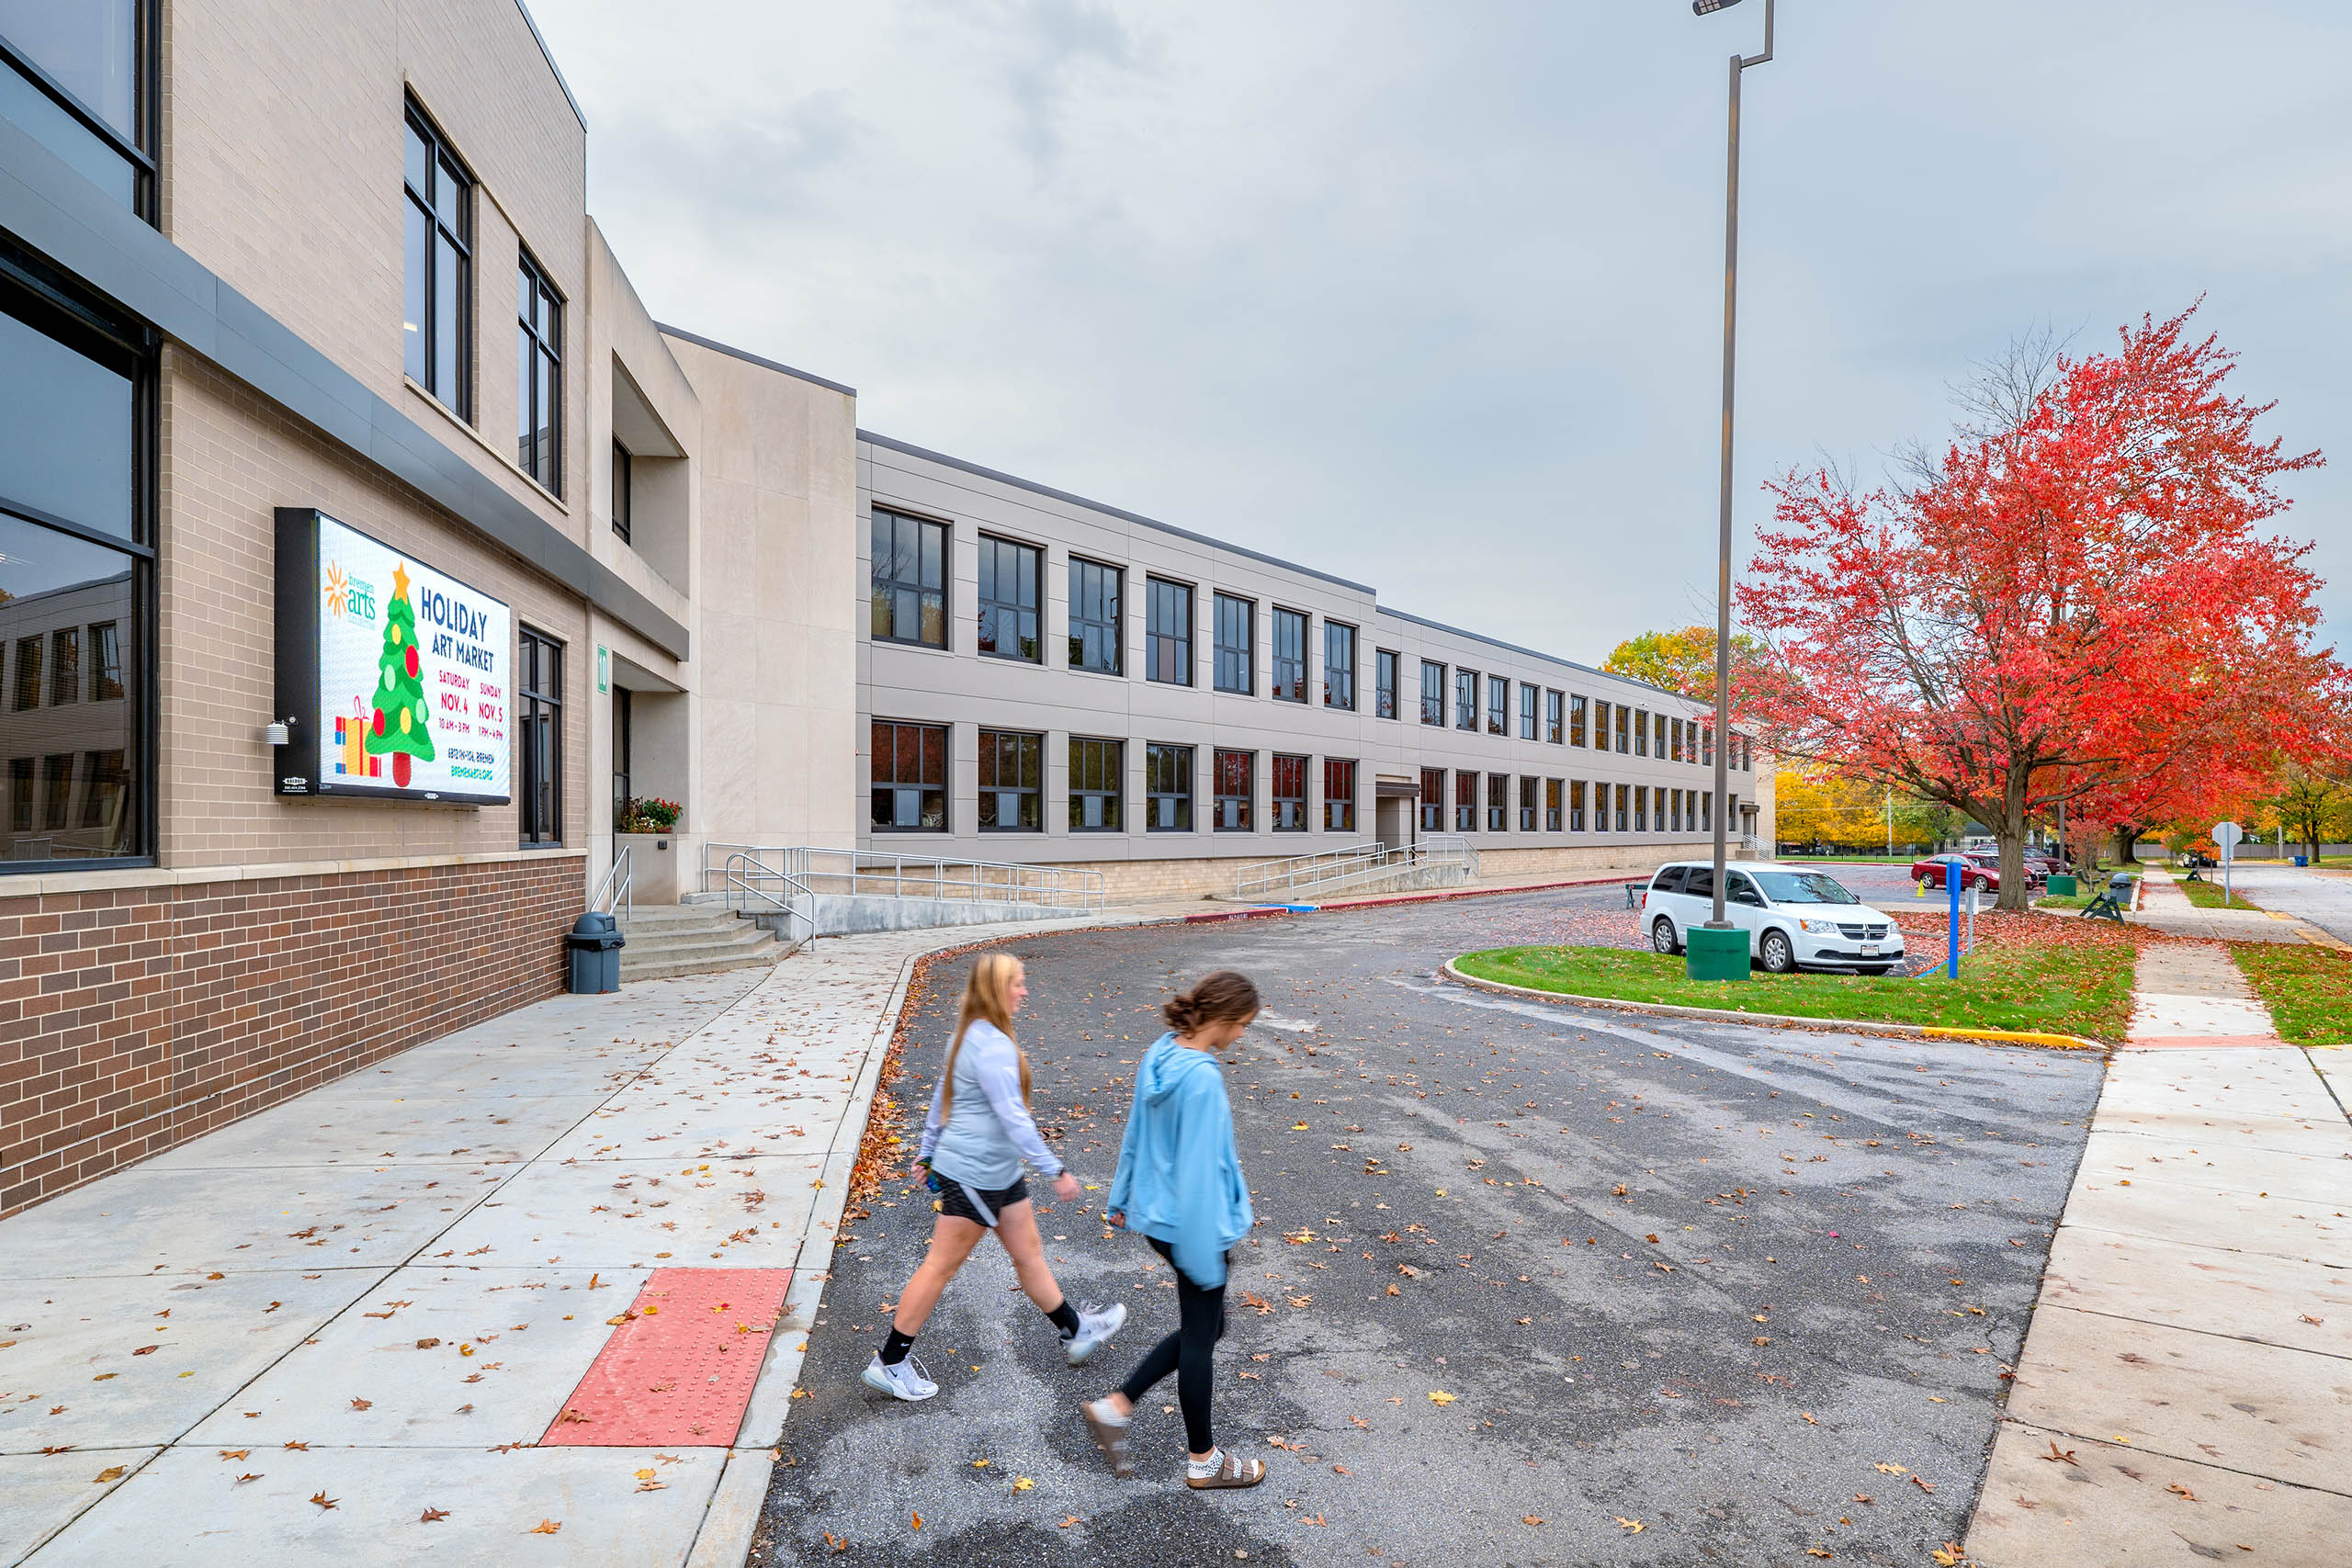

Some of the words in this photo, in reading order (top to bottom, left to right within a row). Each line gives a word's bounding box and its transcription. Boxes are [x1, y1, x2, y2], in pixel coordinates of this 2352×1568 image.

[348, 589, 375, 620] arts
[422, 586, 487, 642] HOLIDAY
[433, 632, 453, 659] ART
[457, 639, 493, 672] MARKET
[439, 670, 469, 690] SATURDAY
[598, 653, 607, 686] 10
[480, 682, 502, 699] SUNDAY
[441, 692, 461, 713] NOV.
[463, 697, 469, 715] 4
[479, 702, 497, 721] NOV.
[498, 706, 503, 723] 5
[447, 719, 454, 730] AM
[462, 722, 470, 734] PM
[481, 727, 489, 739] PM
[496, 729, 503, 740] PM
